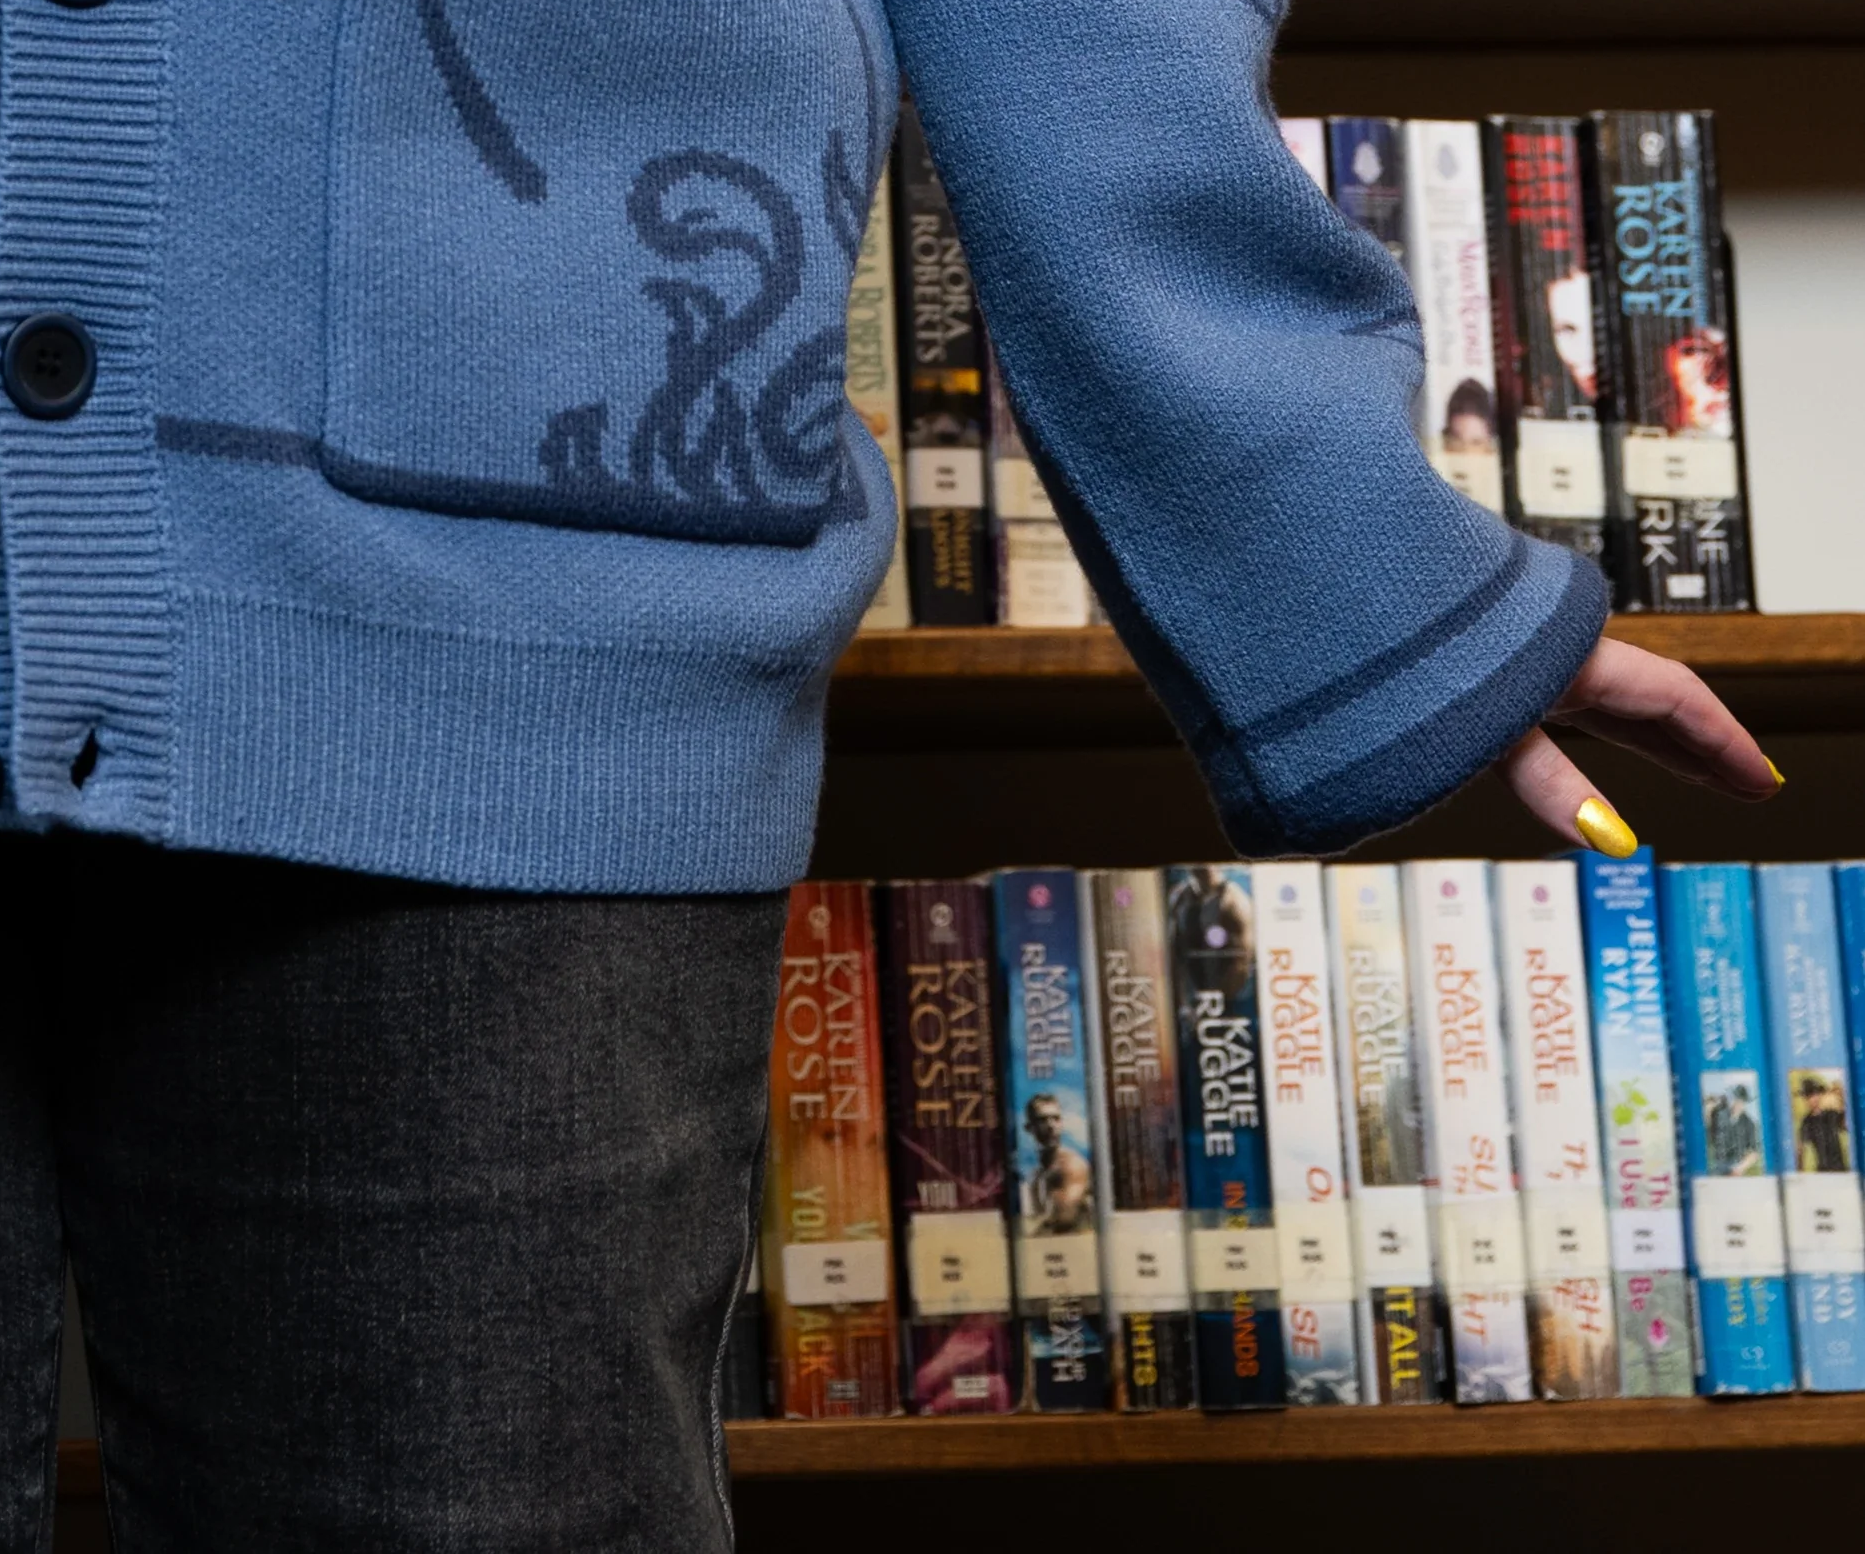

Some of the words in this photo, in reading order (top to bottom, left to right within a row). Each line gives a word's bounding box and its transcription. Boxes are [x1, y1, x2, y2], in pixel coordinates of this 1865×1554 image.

[1503, 133, 1536, 224] ROSE
[1537, 133, 1573, 251] KAREN
[910, 213, 947, 365] ROBERTS
[939, 237, 973, 342] NORA
[1612, 183, 1660, 317] ROSE
[1651, 178, 1694, 319] KAREN
[1636, 498, 1677, 567] RK
[783, 955, 828, 1122] ROSE
[822, 950, 869, 1122] KAREN
[906, 963, 951, 1129] ROSE
[944, 960, 988, 1129] KAREN
[1019, 942, 1055, 1081] RUGGLE
[1044, 963, 1075, 1058] KATIE
[1102, 949, 1146, 1109] RUGGLE
[1127, 974, 1163, 1083] KATIE
[1267, 946, 1303, 1105] RUGGLE
[1295, 972, 1327, 1079] KATIE
[1346, 945, 1388, 1108] RUGGLE
[1378, 971, 1410, 1080] KATIE
[1434, 943, 1468, 1100] RUGGLE
[1454, 969, 1487, 1073] KATIE
[1523, 948, 1561, 1106] RUGGLE
[1547, 973, 1580, 1078] KATIE
[1600, 948, 1642, 1038] RYAN
[1625, 914, 1664, 1073] JENNIFER
[1194, 990, 1238, 1158] RUGGLE
[1225, 1016, 1260, 1129] KATIE
[790, 1186, 828, 1244] YOU
[1619, 1159, 1644, 1209] Use
[1647, 1173, 1670, 1208] Th
[796, 1310, 834, 1377] ACK
[1385, 1324, 1421, 1388] ALL
